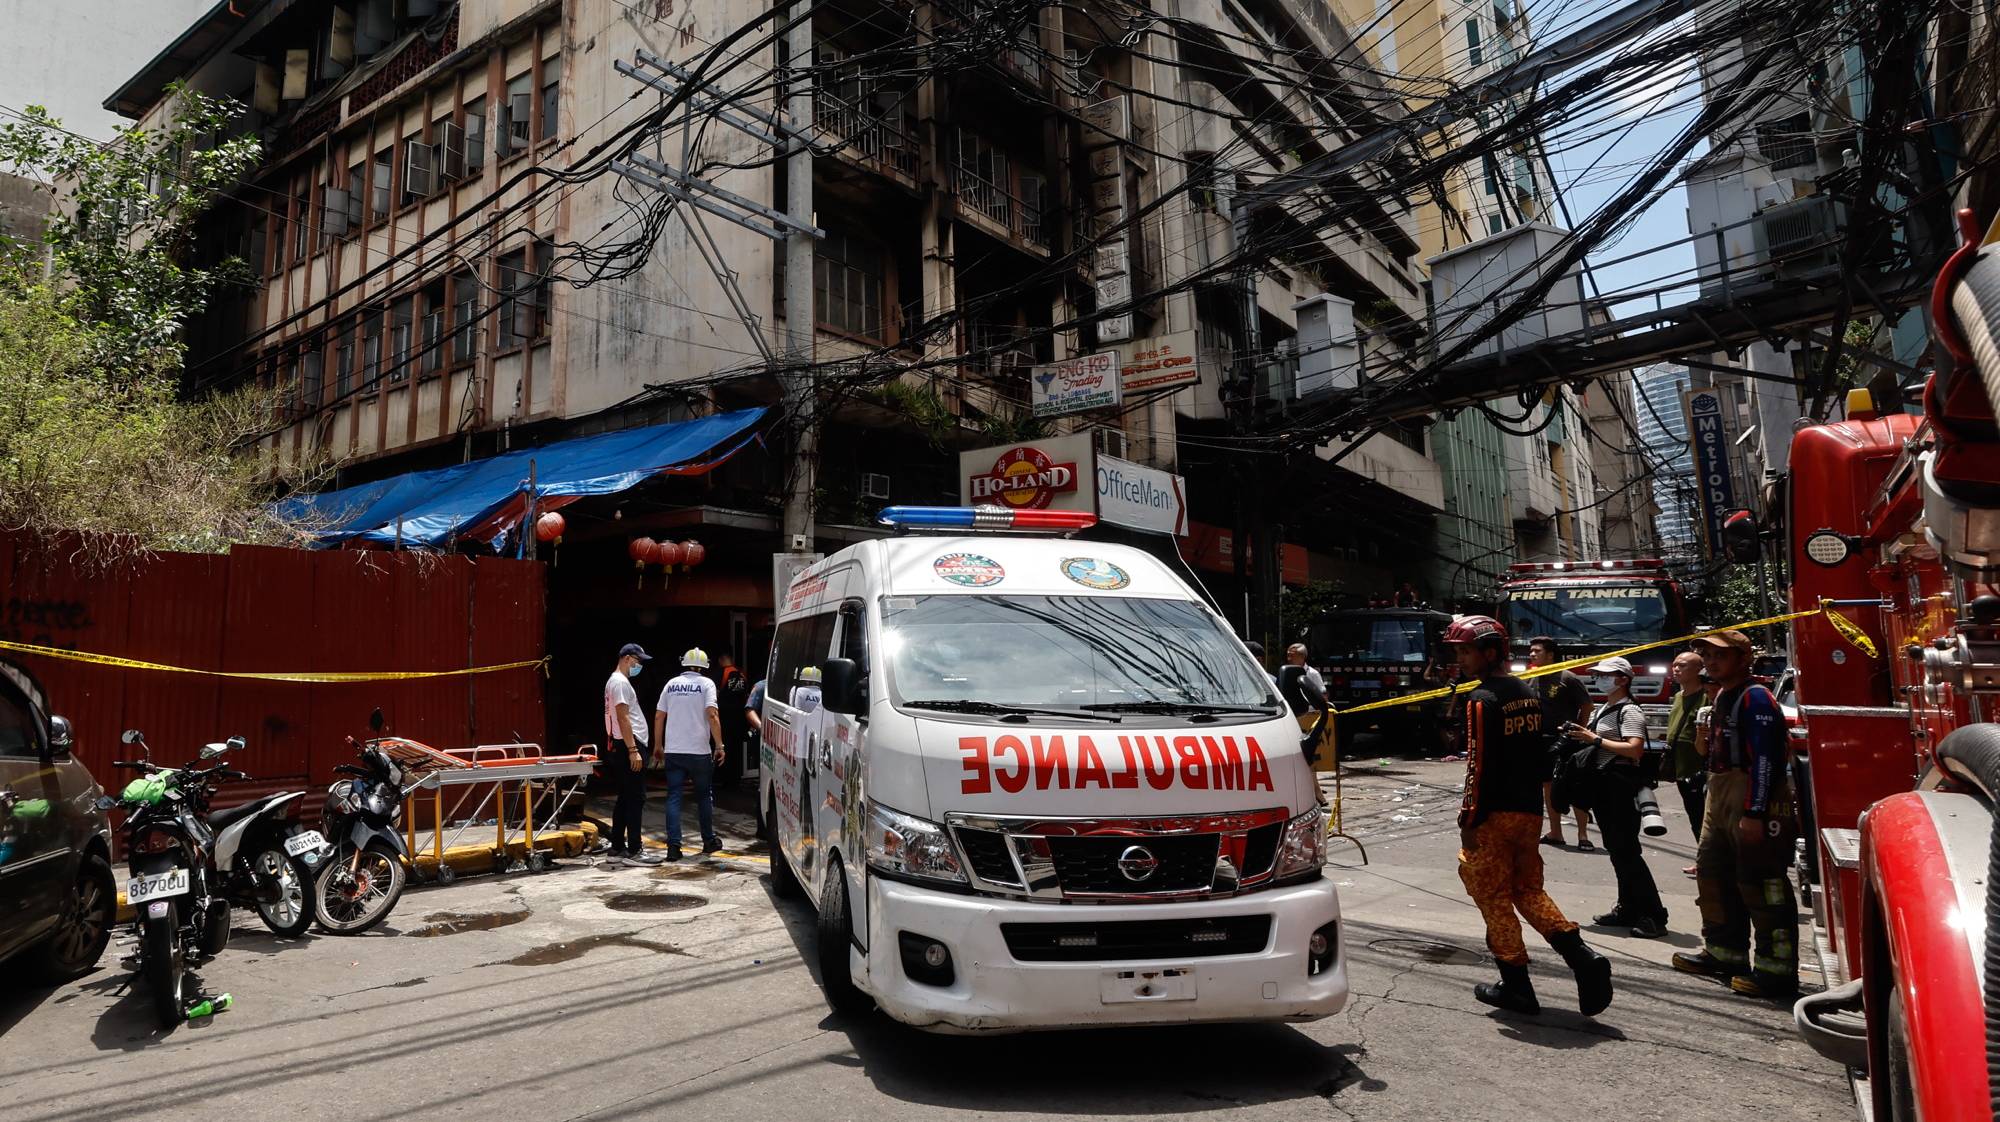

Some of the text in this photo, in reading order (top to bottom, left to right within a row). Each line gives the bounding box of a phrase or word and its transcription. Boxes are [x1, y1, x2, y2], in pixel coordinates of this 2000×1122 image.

[1087, 355, 1110, 376] KO
[1062, 374, 1104, 392] Trading
[1085, 390, 1113, 401] EQUIPMENT
[1098, 467, 1169, 510] OfficeMan
[1699, 418, 1726, 549] Metroba
[1510, 588, 1660, 601] FIRE TANKER
[667, 684, 702, 694] MANILA
[1768, 820, 1781, 837] 9
